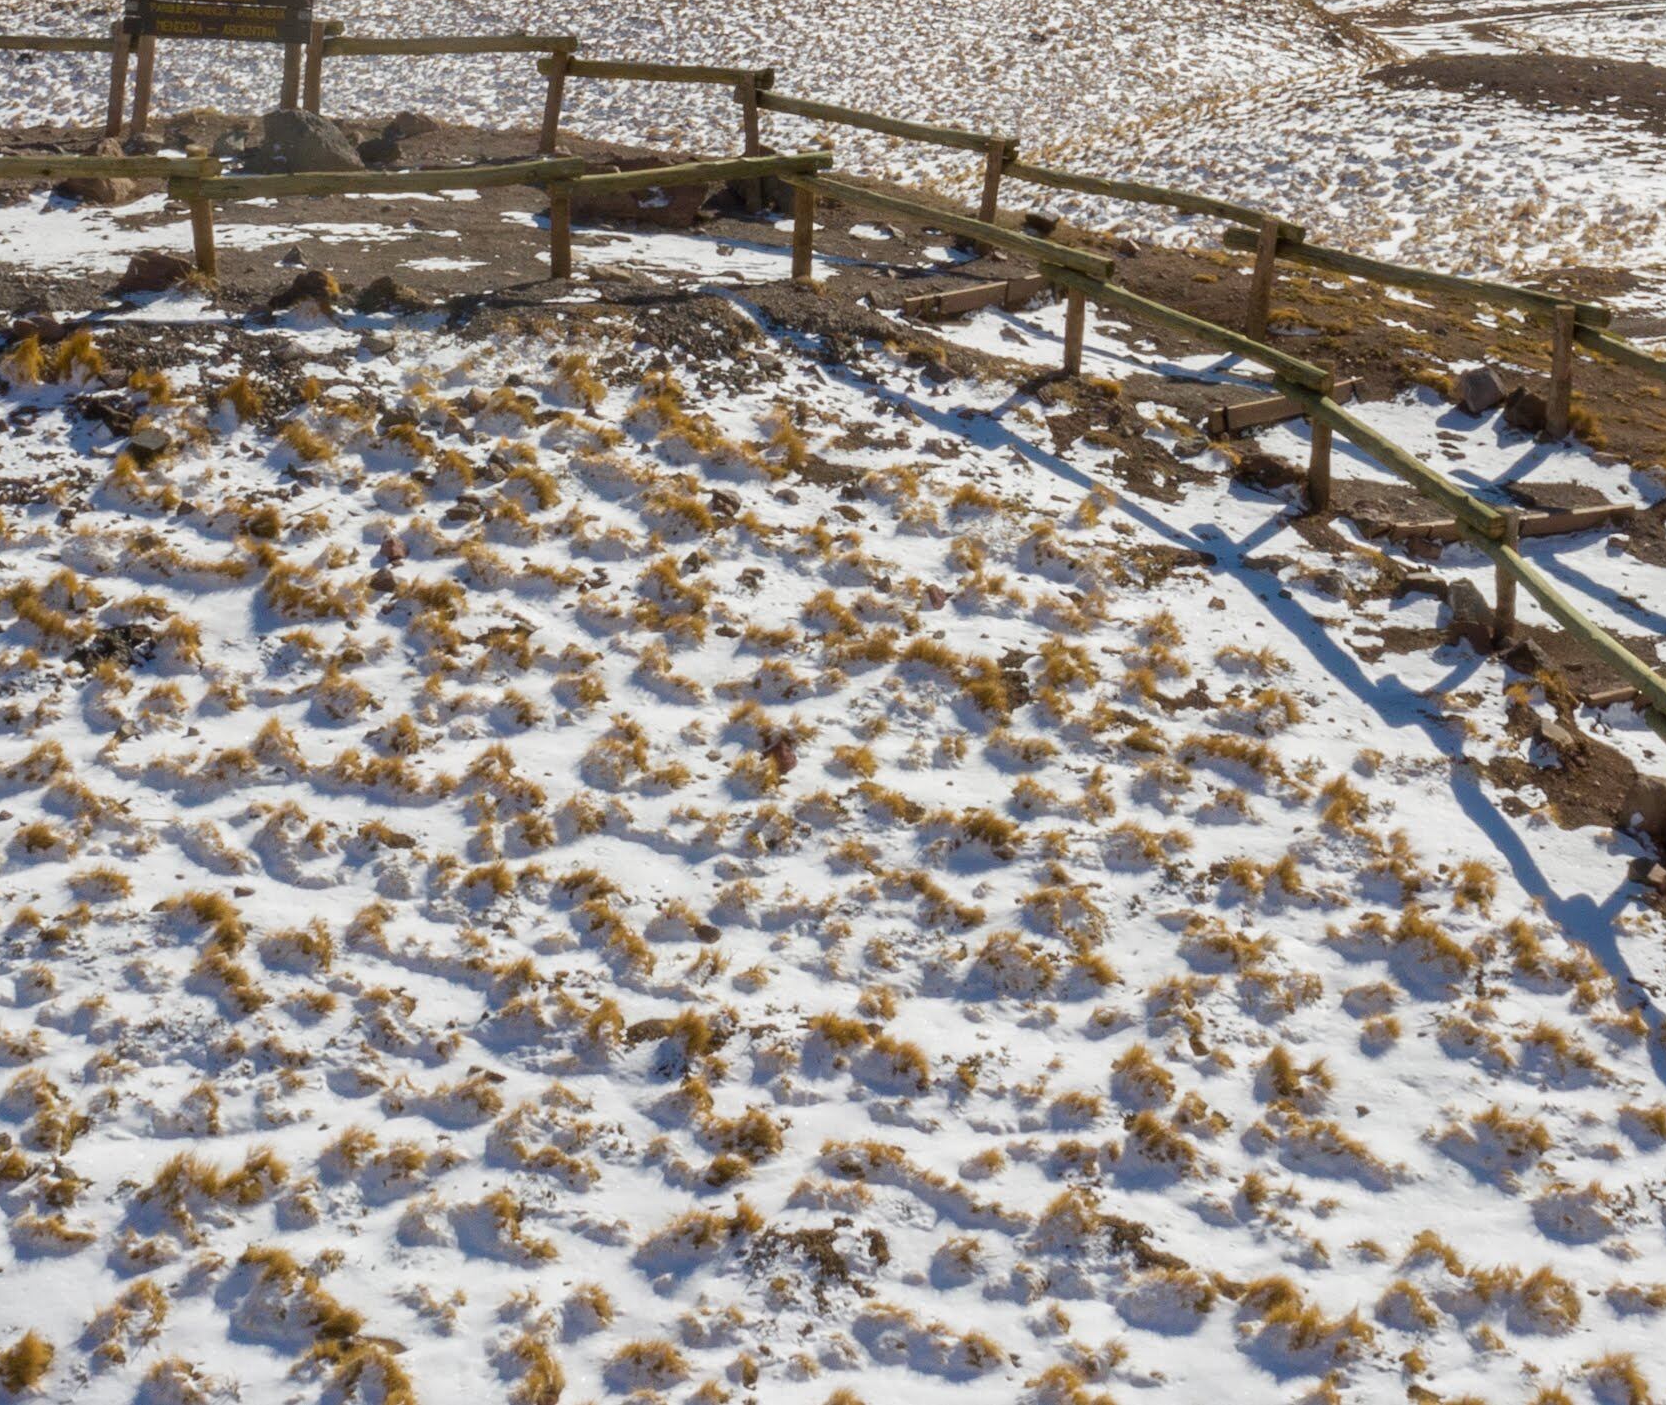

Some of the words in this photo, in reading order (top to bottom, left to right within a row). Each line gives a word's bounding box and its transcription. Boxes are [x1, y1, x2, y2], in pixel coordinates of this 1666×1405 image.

[236, 7, 286, 21] ACONCAGUA
[156, 19, 202, 34] MENDOZA
[222, 22, 277, 38] ARGENTINA
